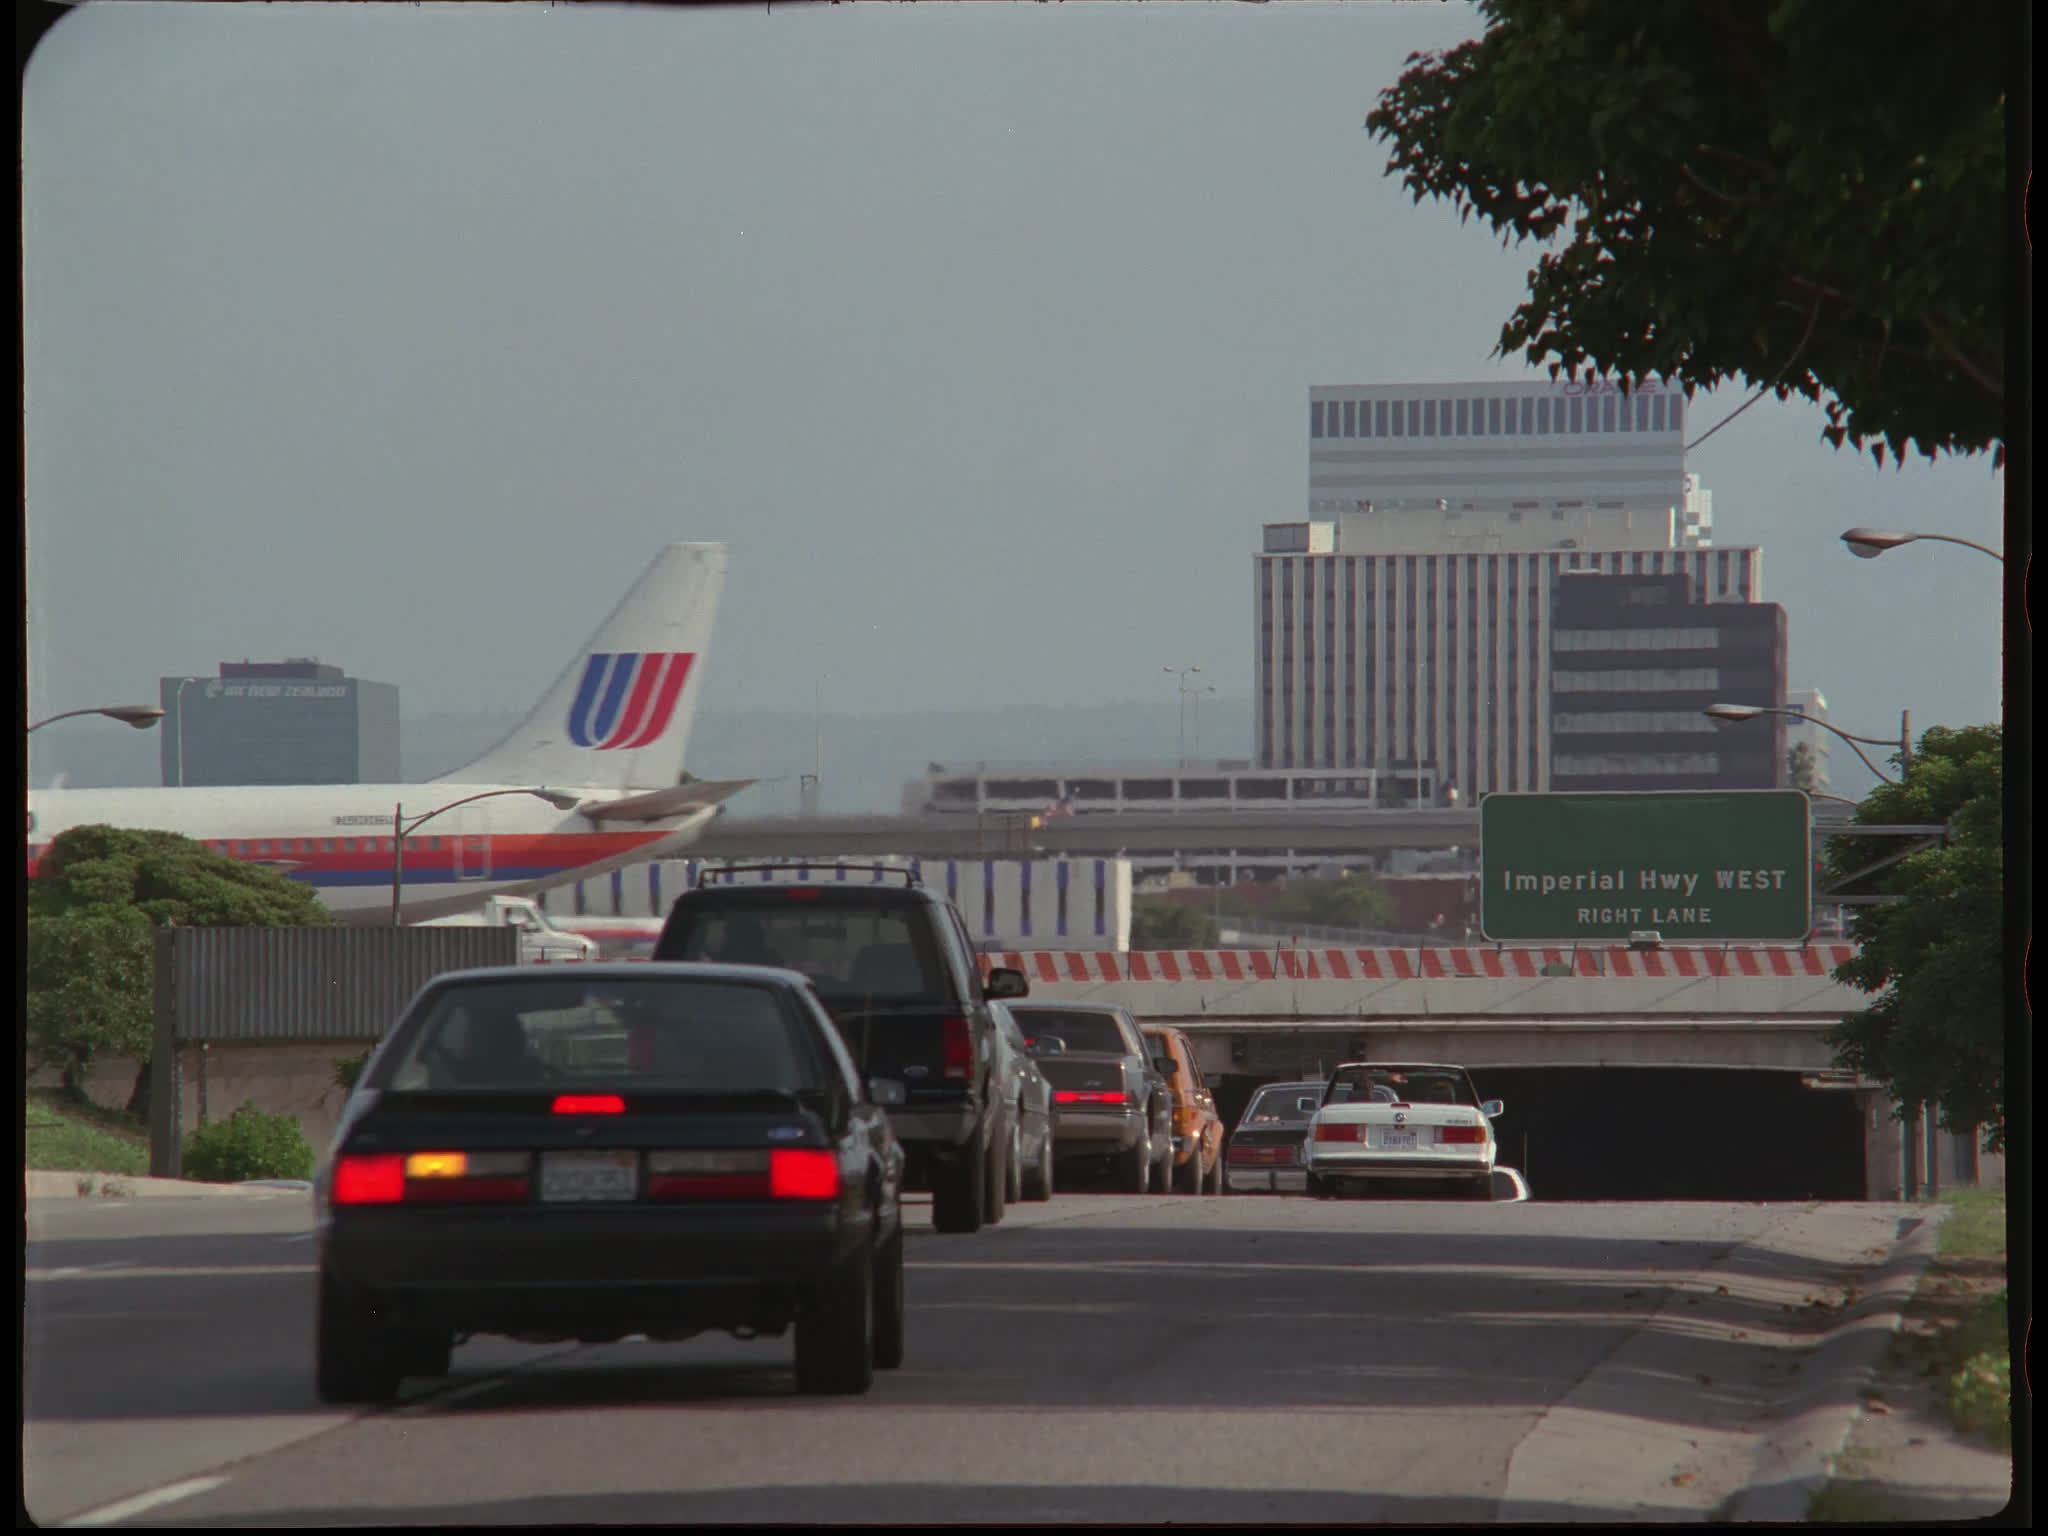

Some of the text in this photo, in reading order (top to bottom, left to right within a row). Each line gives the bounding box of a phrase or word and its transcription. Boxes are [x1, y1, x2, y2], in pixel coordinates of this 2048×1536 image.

[1504, 869, 1786, 896] Imperial Hwy WEST
[1577, 907, 1711, 924] RIGHT LANE
